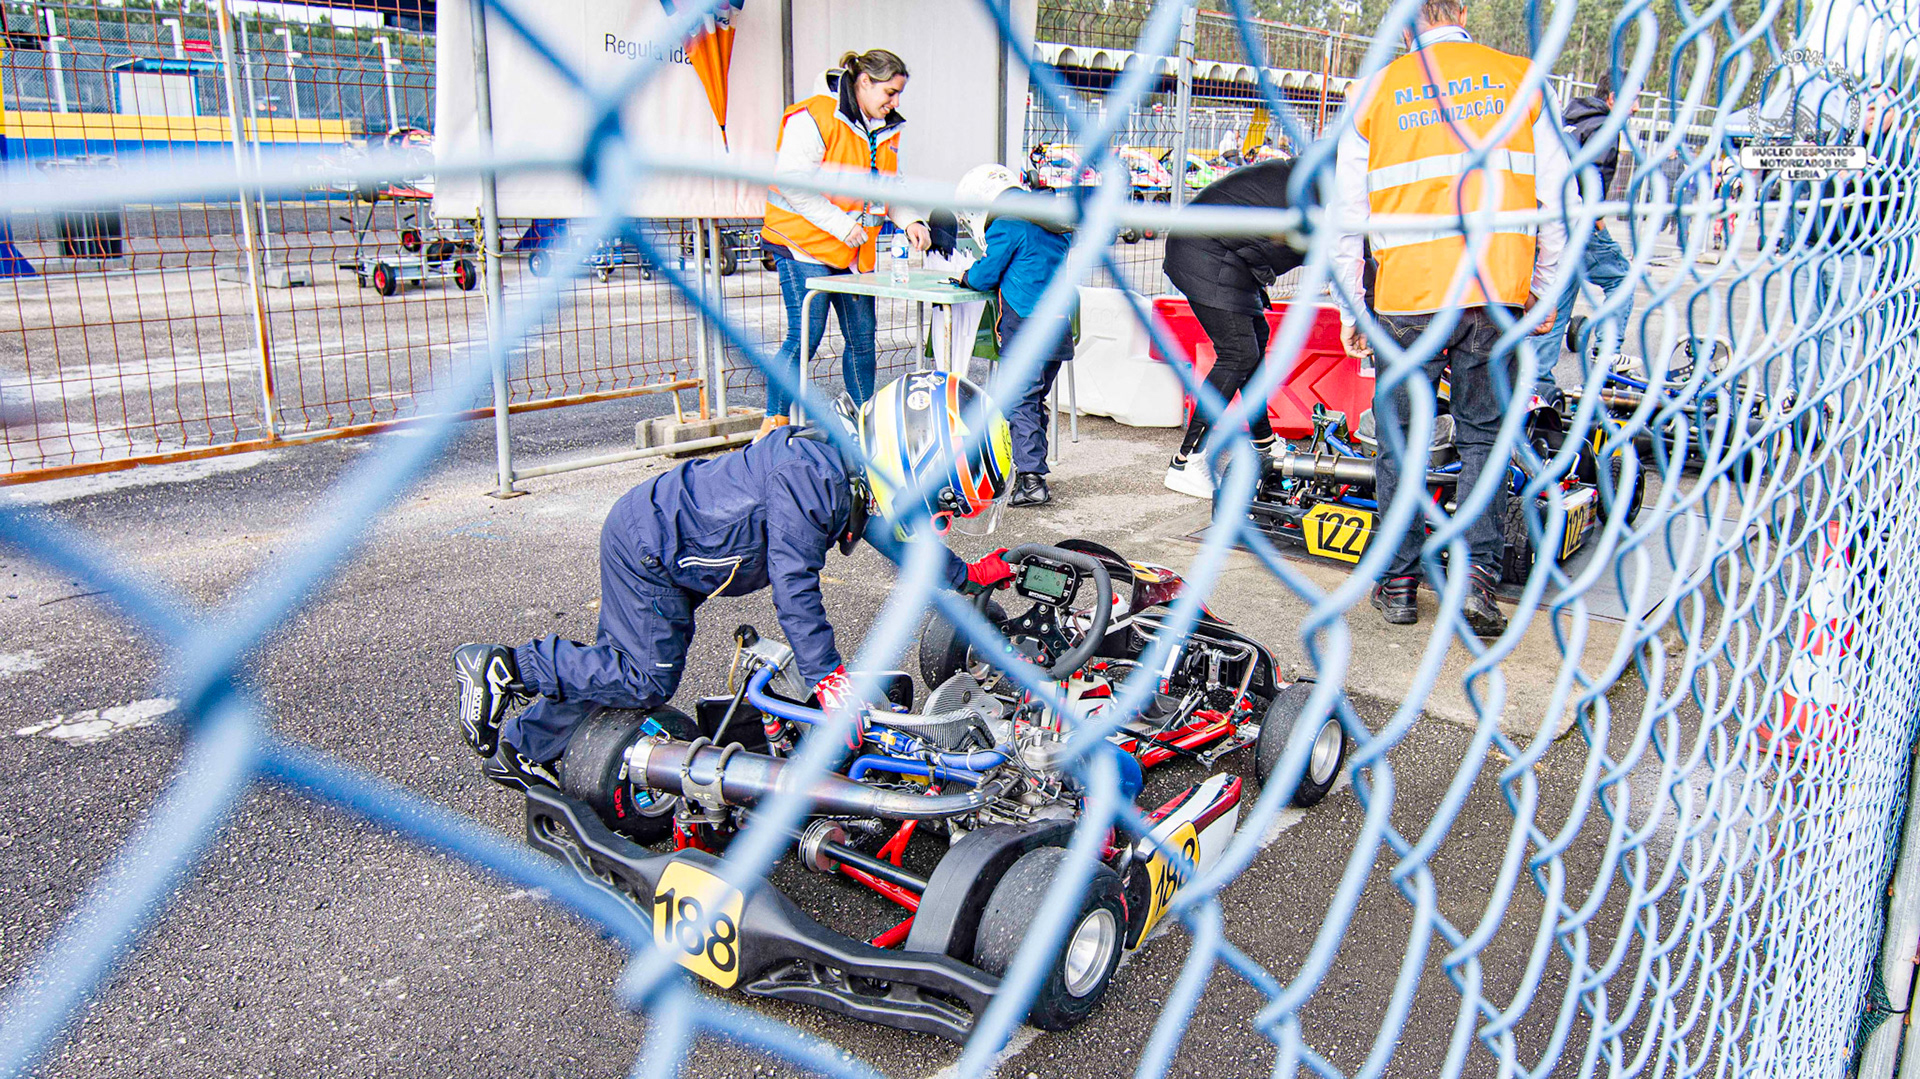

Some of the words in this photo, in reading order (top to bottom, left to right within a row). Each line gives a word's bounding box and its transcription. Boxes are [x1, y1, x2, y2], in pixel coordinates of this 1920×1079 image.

[1394, 75, 1505, 106] N.D.M.L.
[1398, 95, 1505, 131] ORGANIZAÇÃO
[1315, 511, 1365, 556] 122
[1566, 505, 1585, 555] 122
[1155, 837, 1196, 917] 188
[655, 887, 737, 973] 188
